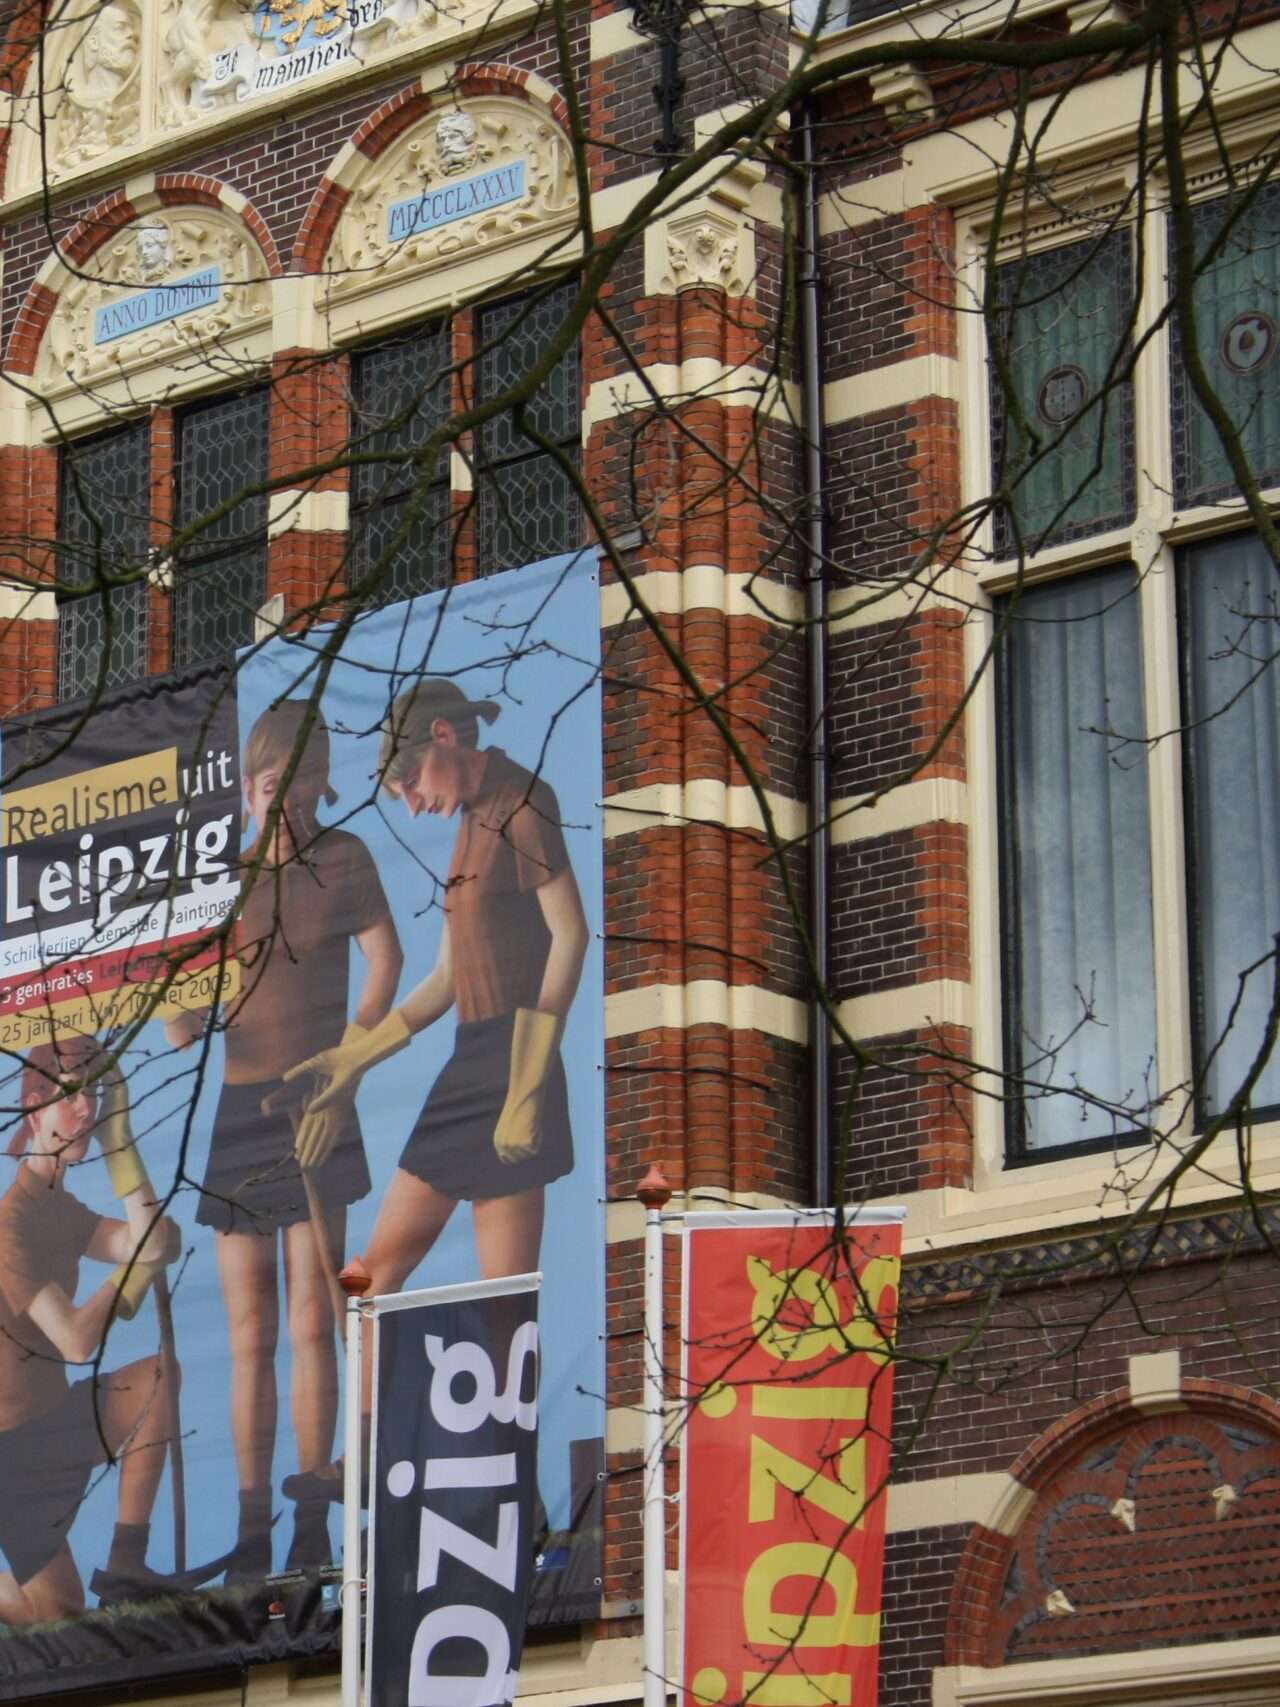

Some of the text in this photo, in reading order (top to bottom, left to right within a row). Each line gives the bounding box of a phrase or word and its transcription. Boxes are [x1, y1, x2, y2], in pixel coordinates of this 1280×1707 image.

[99, 273, 213, 336] ANNO DOMINI
[7, 749, 235, 845] Realisme uit
[5, 807, 242, 928] Leipzig
[3, 935, 87, 967] Schilderijen
[1, 1022, 22, 1044] 25
[25, 1007, 83, 1044] januari
[189, 971, 233, 999] 2009
[15, 969, 94, 1006] generaties
